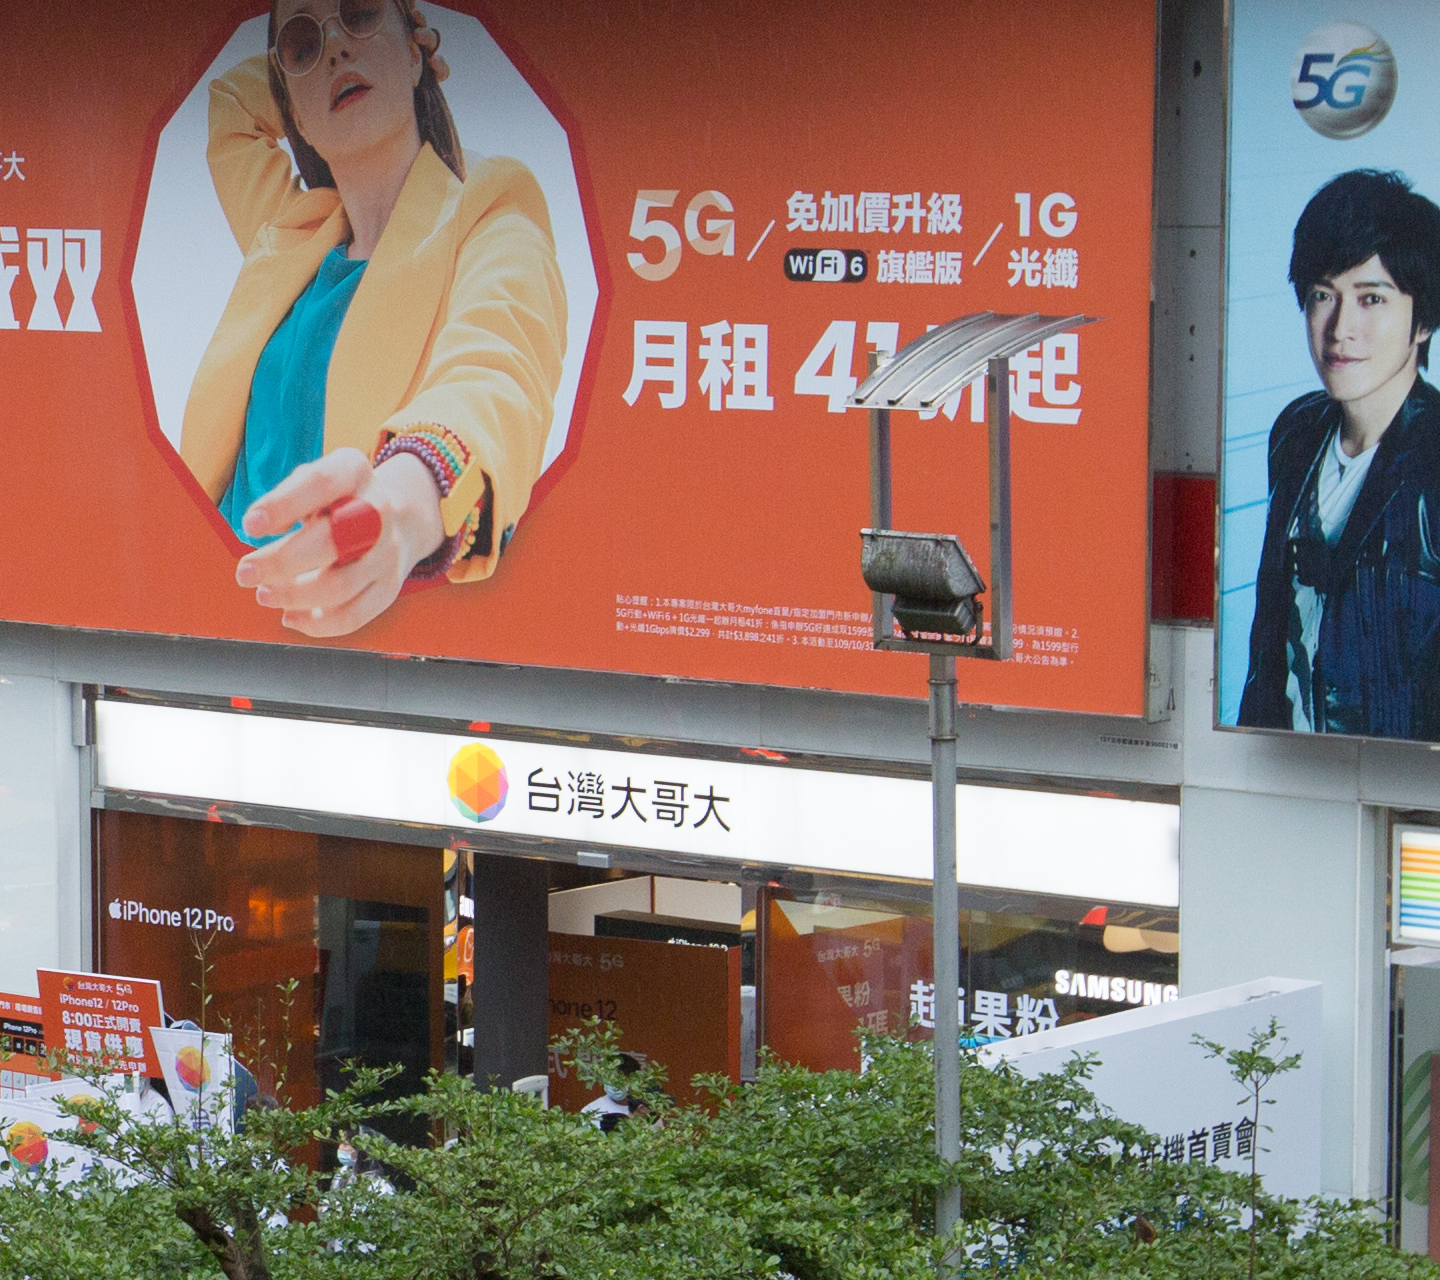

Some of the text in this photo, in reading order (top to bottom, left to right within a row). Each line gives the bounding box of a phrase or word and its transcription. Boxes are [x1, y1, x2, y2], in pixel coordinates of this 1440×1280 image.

[1293, 52, 1371, 110] 5G
[626, 189, 1078, 282] 5G 免加價升級 1G
[877, 250, 962, 286] 旗艦版
[1007, 247, 1079, 290] 光纖
[621, 319, 775, 413] 月租
[526, 766, 732, 833] 台灣大哥大
[123, 900, 235, 932] iPhone 12 Pro
[1054, 969, 1179, 1006] SAMSUNG
